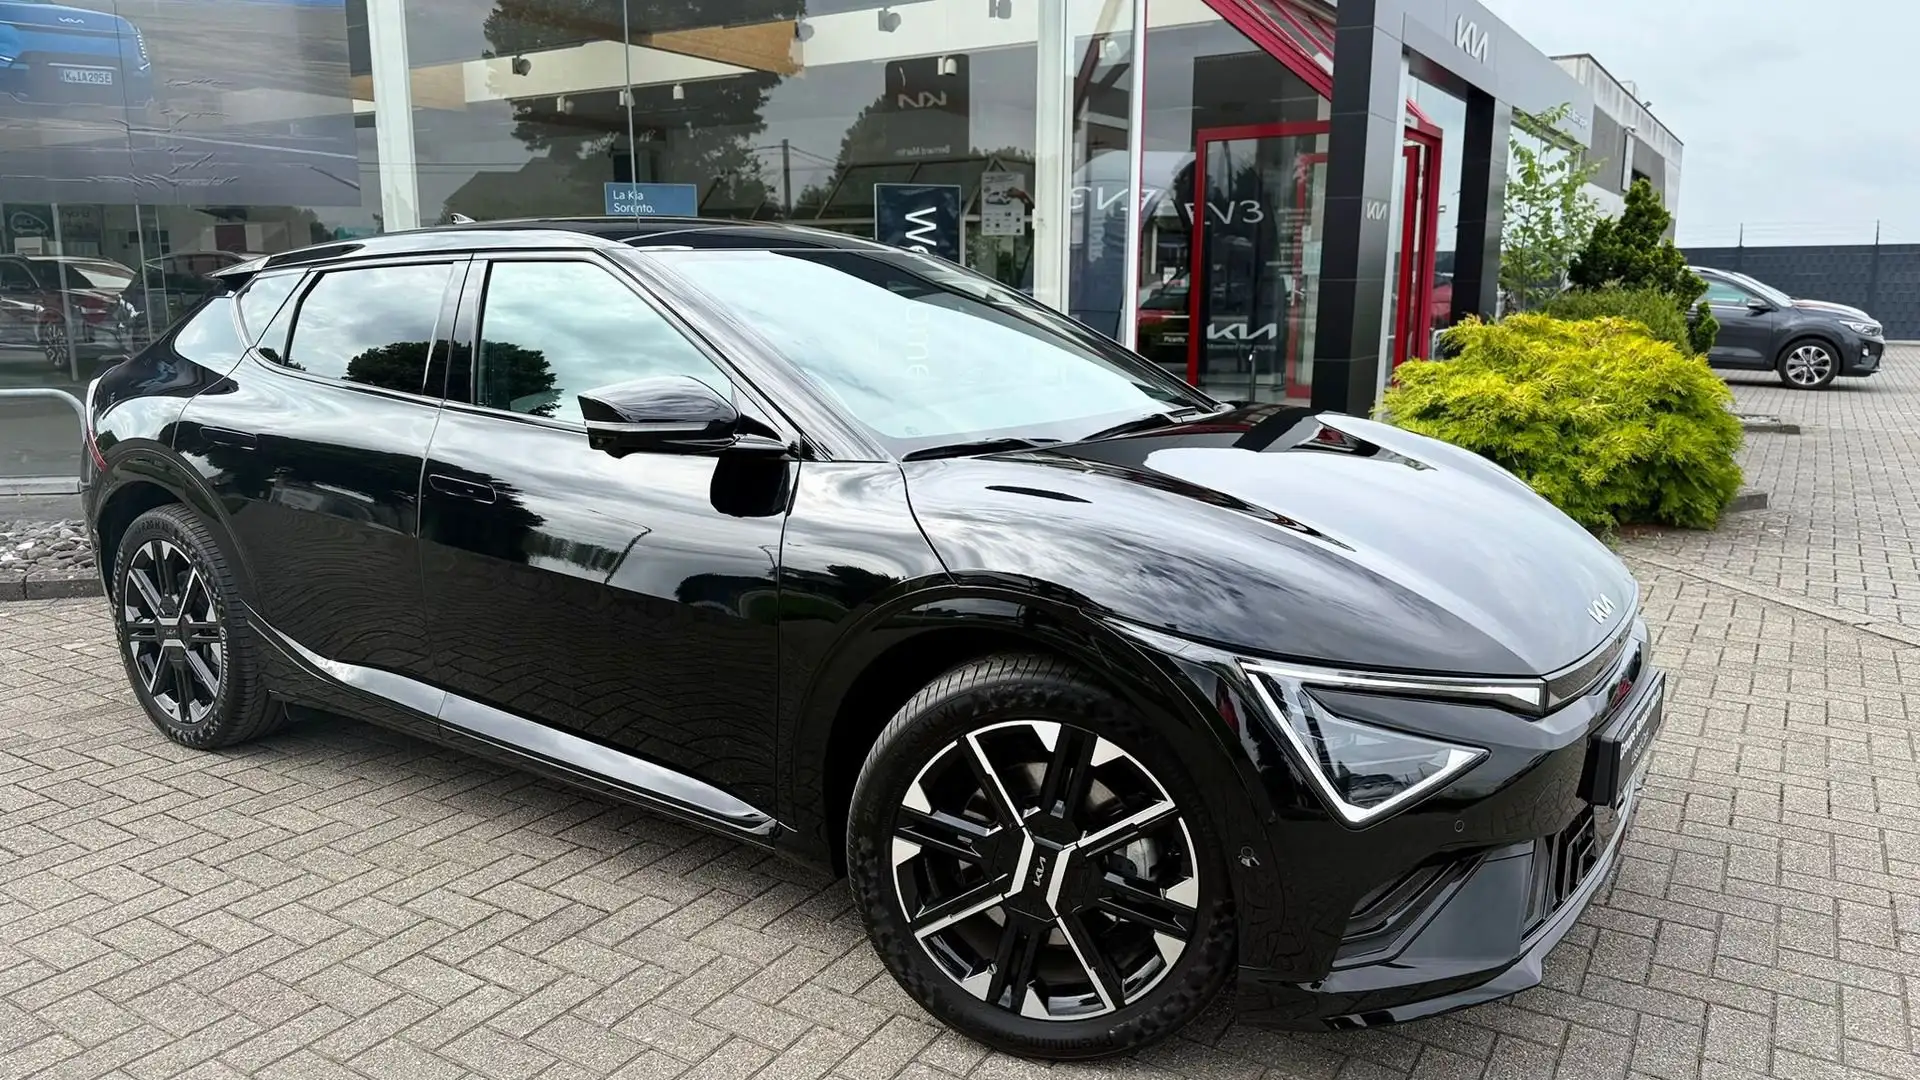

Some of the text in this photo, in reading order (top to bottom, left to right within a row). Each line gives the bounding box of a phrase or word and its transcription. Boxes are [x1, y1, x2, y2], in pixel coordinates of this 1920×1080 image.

[1455, 12, 1489, 65] KIA
[613, 189, 644, 201] La Kia
[614, 202, 656, 214] Sorento.
[1184, 199, 1264, 225] EV3
[1366, 200, 1388, 220] KIA
[1207, 322, 1278, 340] KIA
[1586, 592, 1617, 625] KIA
[1033, 855, 1047, 887] KIA
